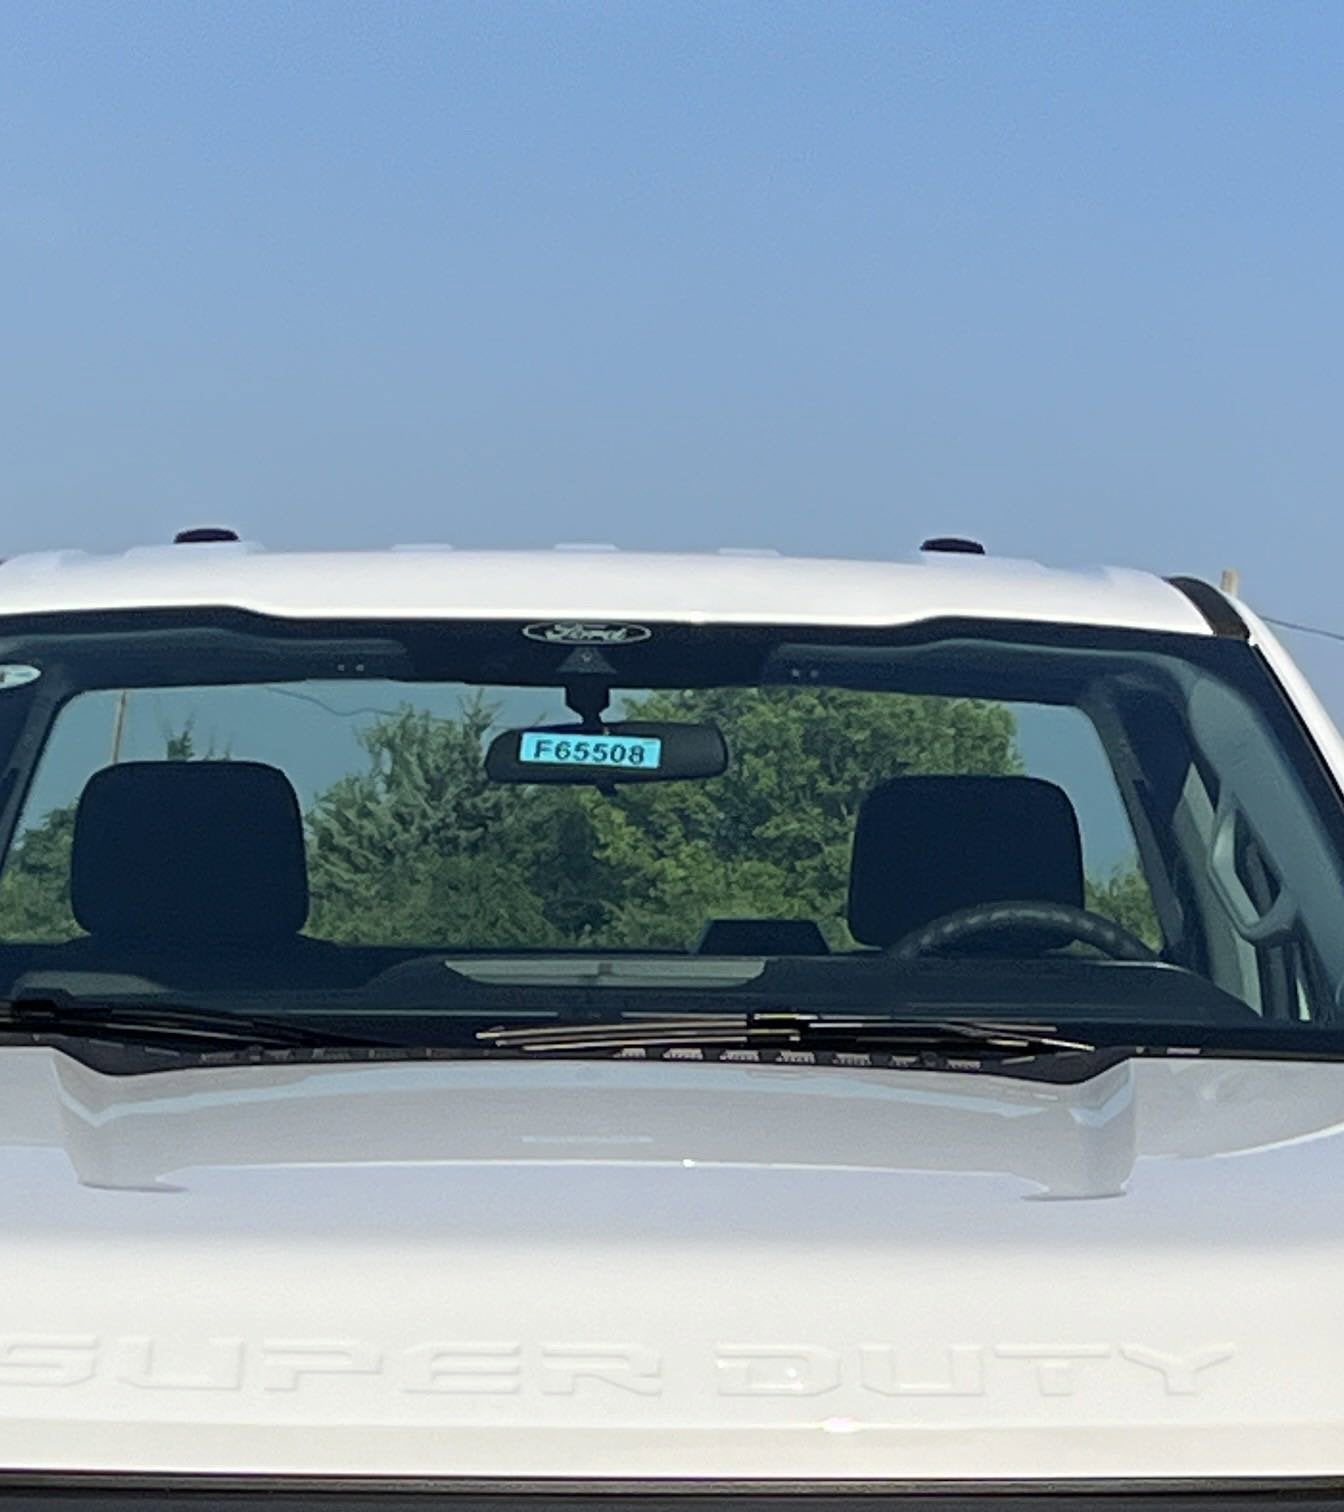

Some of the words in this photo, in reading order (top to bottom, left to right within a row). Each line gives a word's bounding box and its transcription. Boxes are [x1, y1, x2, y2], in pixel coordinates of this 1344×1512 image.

[545, 622, 627, 640] Ford
[533, 739, 645, 765] F65508
[713, 1342, 1236, 1397] DUTY
